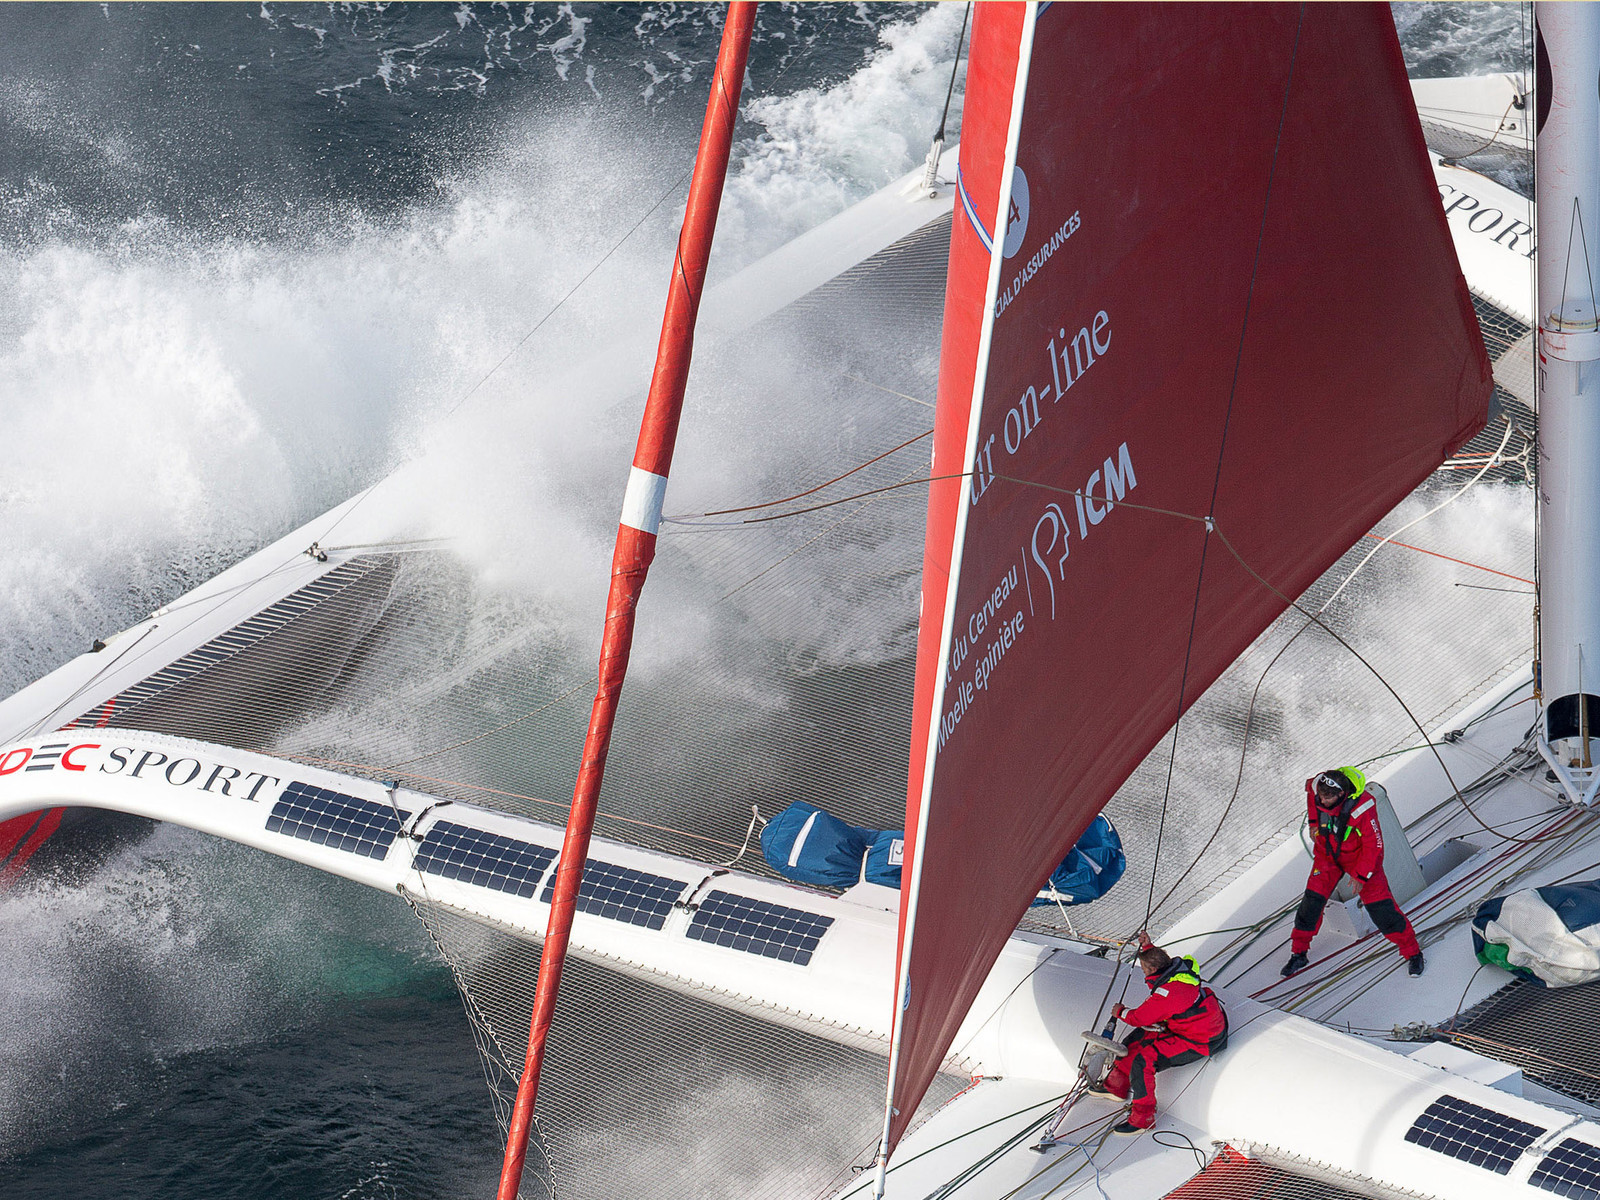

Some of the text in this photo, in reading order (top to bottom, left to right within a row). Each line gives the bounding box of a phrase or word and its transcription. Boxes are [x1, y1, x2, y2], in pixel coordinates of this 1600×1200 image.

[1013, 210, 1082, 295] D'ASSURANCES
[1438, 184, 1537, 260] POR
[1003, 310, 1112, 455] on-line
[1074, 441, 1138, 540] ICM
[953, 564, 1019, 672] du Cerveau
[937, 610, 1025, 754] Moelle épinière
[0, 743, 281, 803] DEC SPORT
